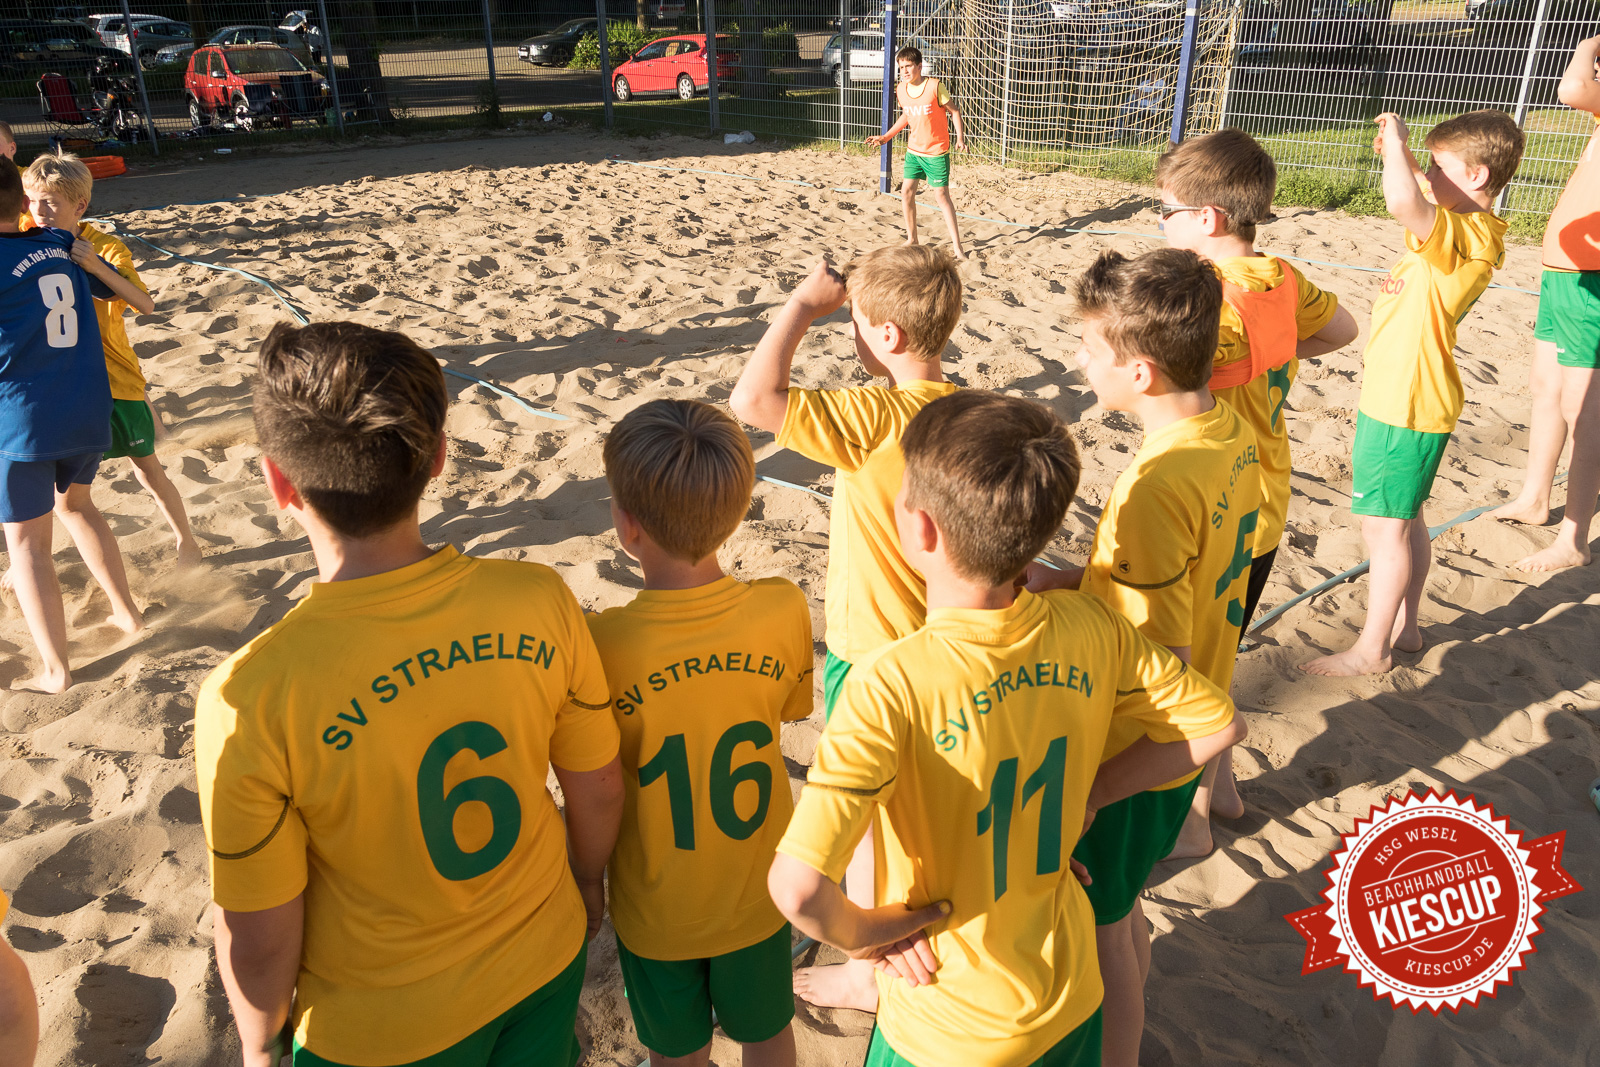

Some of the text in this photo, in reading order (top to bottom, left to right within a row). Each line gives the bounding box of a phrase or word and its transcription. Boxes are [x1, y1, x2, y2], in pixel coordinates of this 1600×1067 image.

[38, 273, 78, 348] 8
[1211, 491, 1230, 530] SV
[322, 632, 556, 751] SV STRAELEN
[616, 652, 786, 716] SV STRAELEN
[935, 662, 1094, 752] SV STRAELEN
[417, 720, 522, 882] 6
[638, 720, 774, 851] 16
[976, 735, 1068, 904] 11
